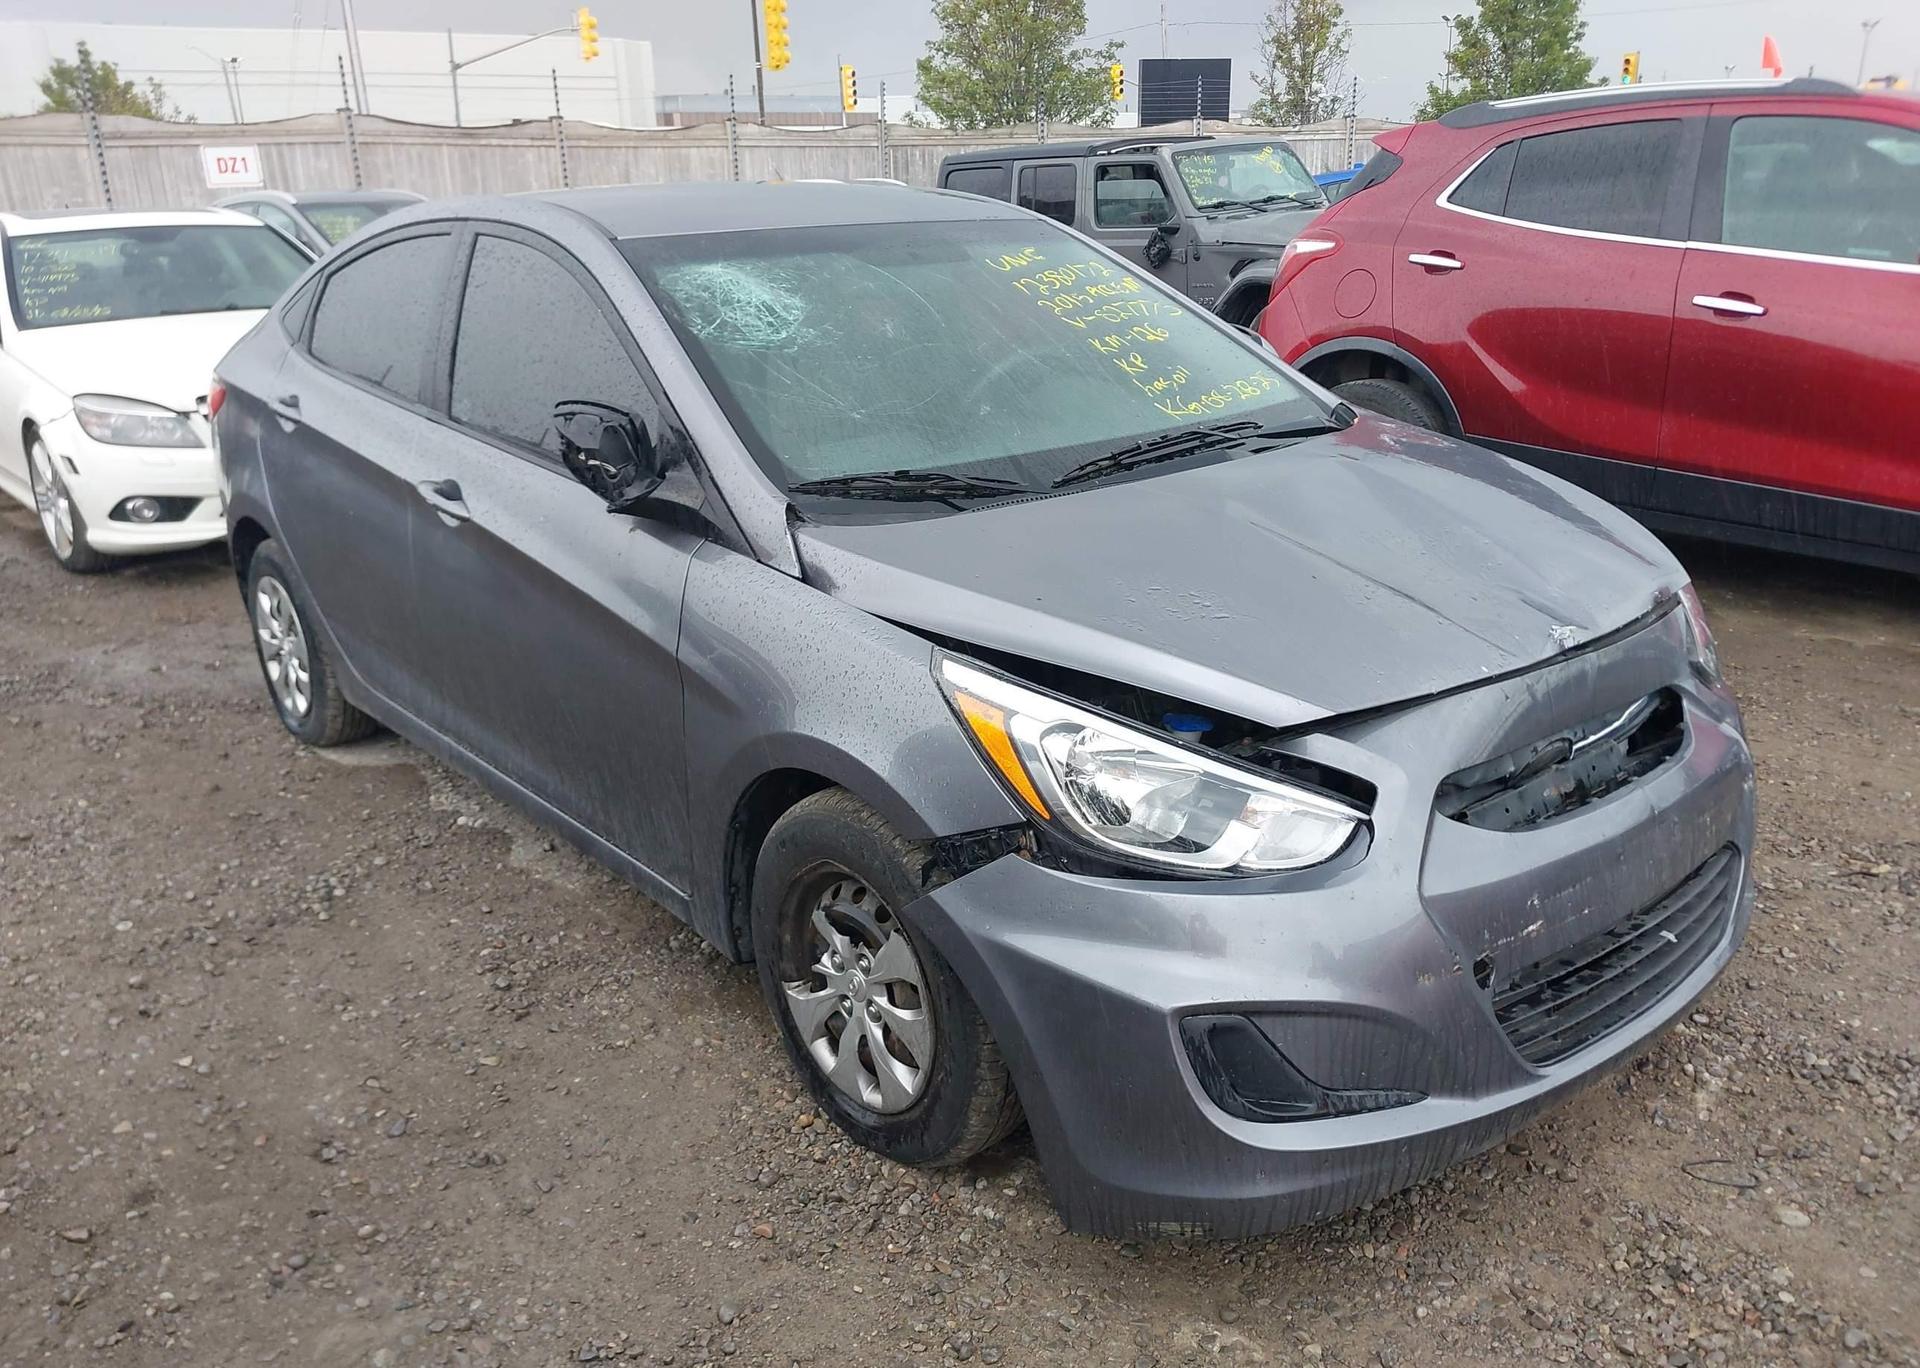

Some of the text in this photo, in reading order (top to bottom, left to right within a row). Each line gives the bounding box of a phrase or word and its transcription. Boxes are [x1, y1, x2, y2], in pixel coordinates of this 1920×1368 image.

[216, 157, 249, 174] DZ1
[1037, 292, 1094, 316] 2015
[1112, 352, 1149, 376] KP
